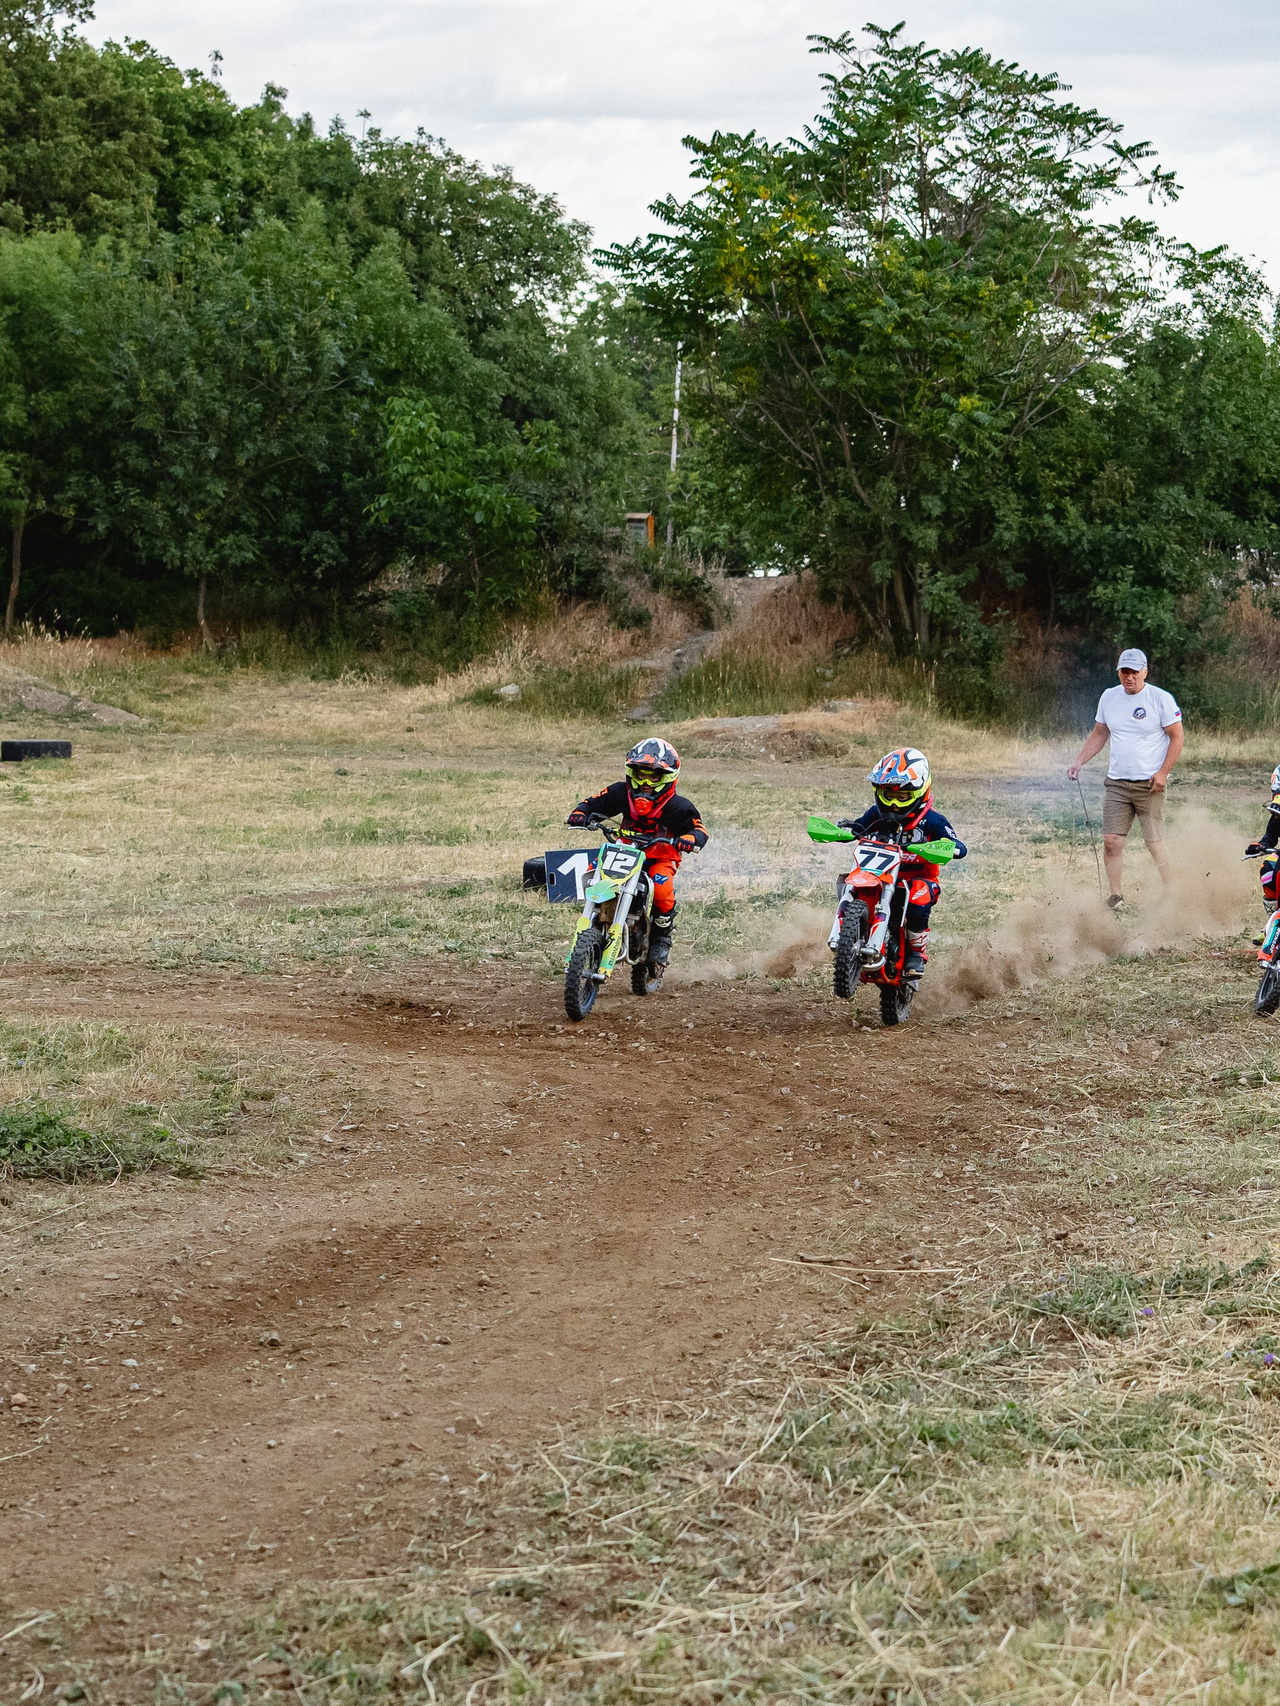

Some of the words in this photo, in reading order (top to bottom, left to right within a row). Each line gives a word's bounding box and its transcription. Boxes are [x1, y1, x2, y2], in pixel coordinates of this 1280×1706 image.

[602, 851, 637, 875] 12
[859, 849, 895, 871] 77
[556, 852, 589, 900] 1
[608, 935, 621, 966] usqvarna
